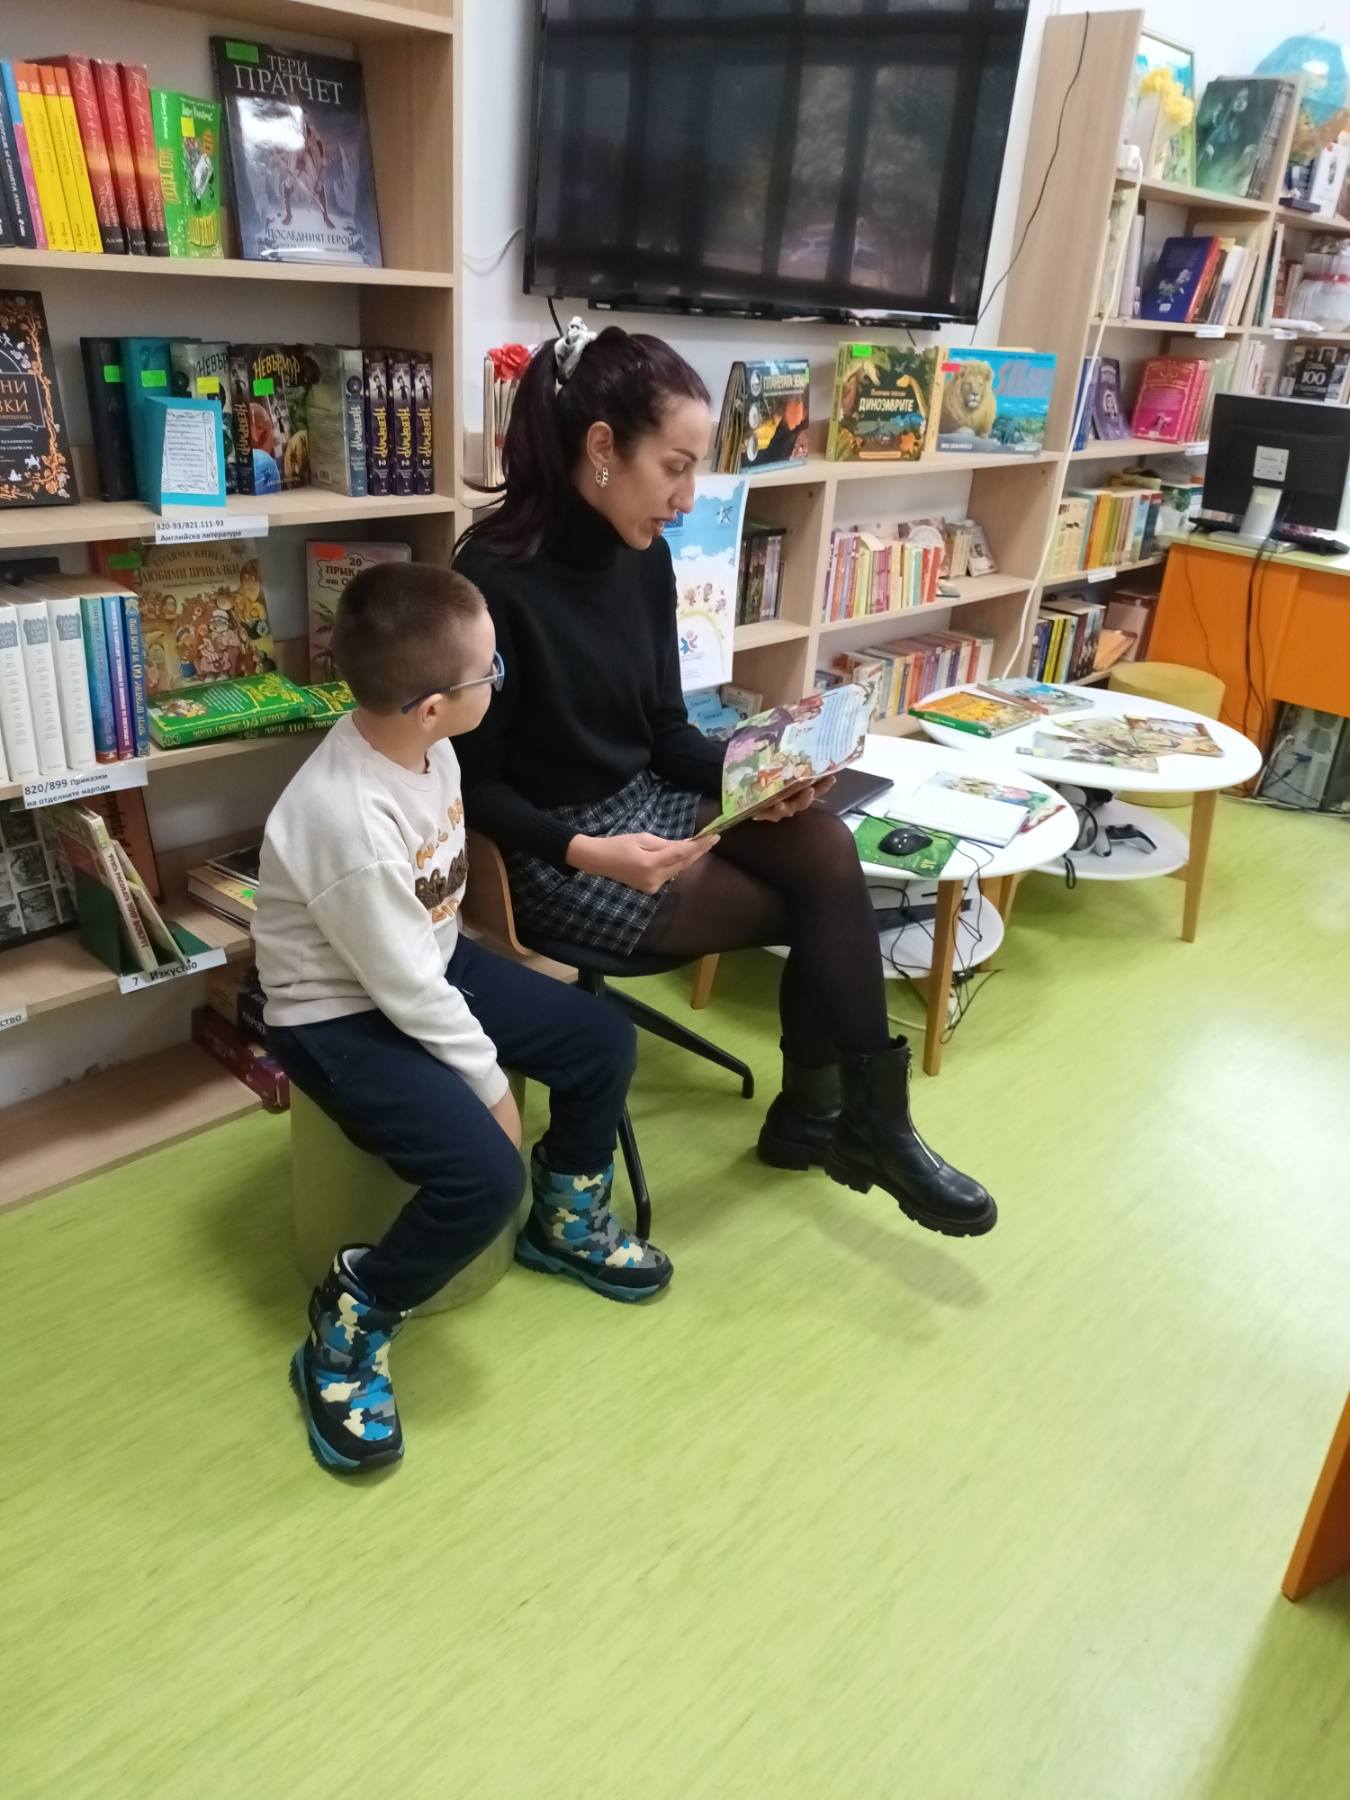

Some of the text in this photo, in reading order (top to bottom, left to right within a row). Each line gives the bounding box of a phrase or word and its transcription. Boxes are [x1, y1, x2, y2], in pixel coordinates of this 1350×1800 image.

[266, 55, 309, 77] ТЕРИ
[233, 64, 344, 105] ПРАТЧЕТ
[267, 228, 354, 247] ПОСЛЕДНИЯТ ГЕРОЙ
[252, 354, 300, 385] НЕВЪРМУР
[1302, 371, 1326, 385] 100
[858, 398, 914, 412] ДИНОЗАВРИТЕ
[372, 407, 388, 458] НЕВЪРМУР
[397, 407, 412, 467] НЕВЪРМУР 2
[418, 407, 432, 458] НЕВЪРМУР
[160, 530, 242, 541] Английска литература
[326, 565, 355, 577] ПРИК
[349, 556, 362, 567] 20
[24, 774, 108, 796] 820/899 Приказки
[38, 791, 80, 805] отделните
[81, 784, 111, 795] народи
[132, 977, 138, 986] 7
